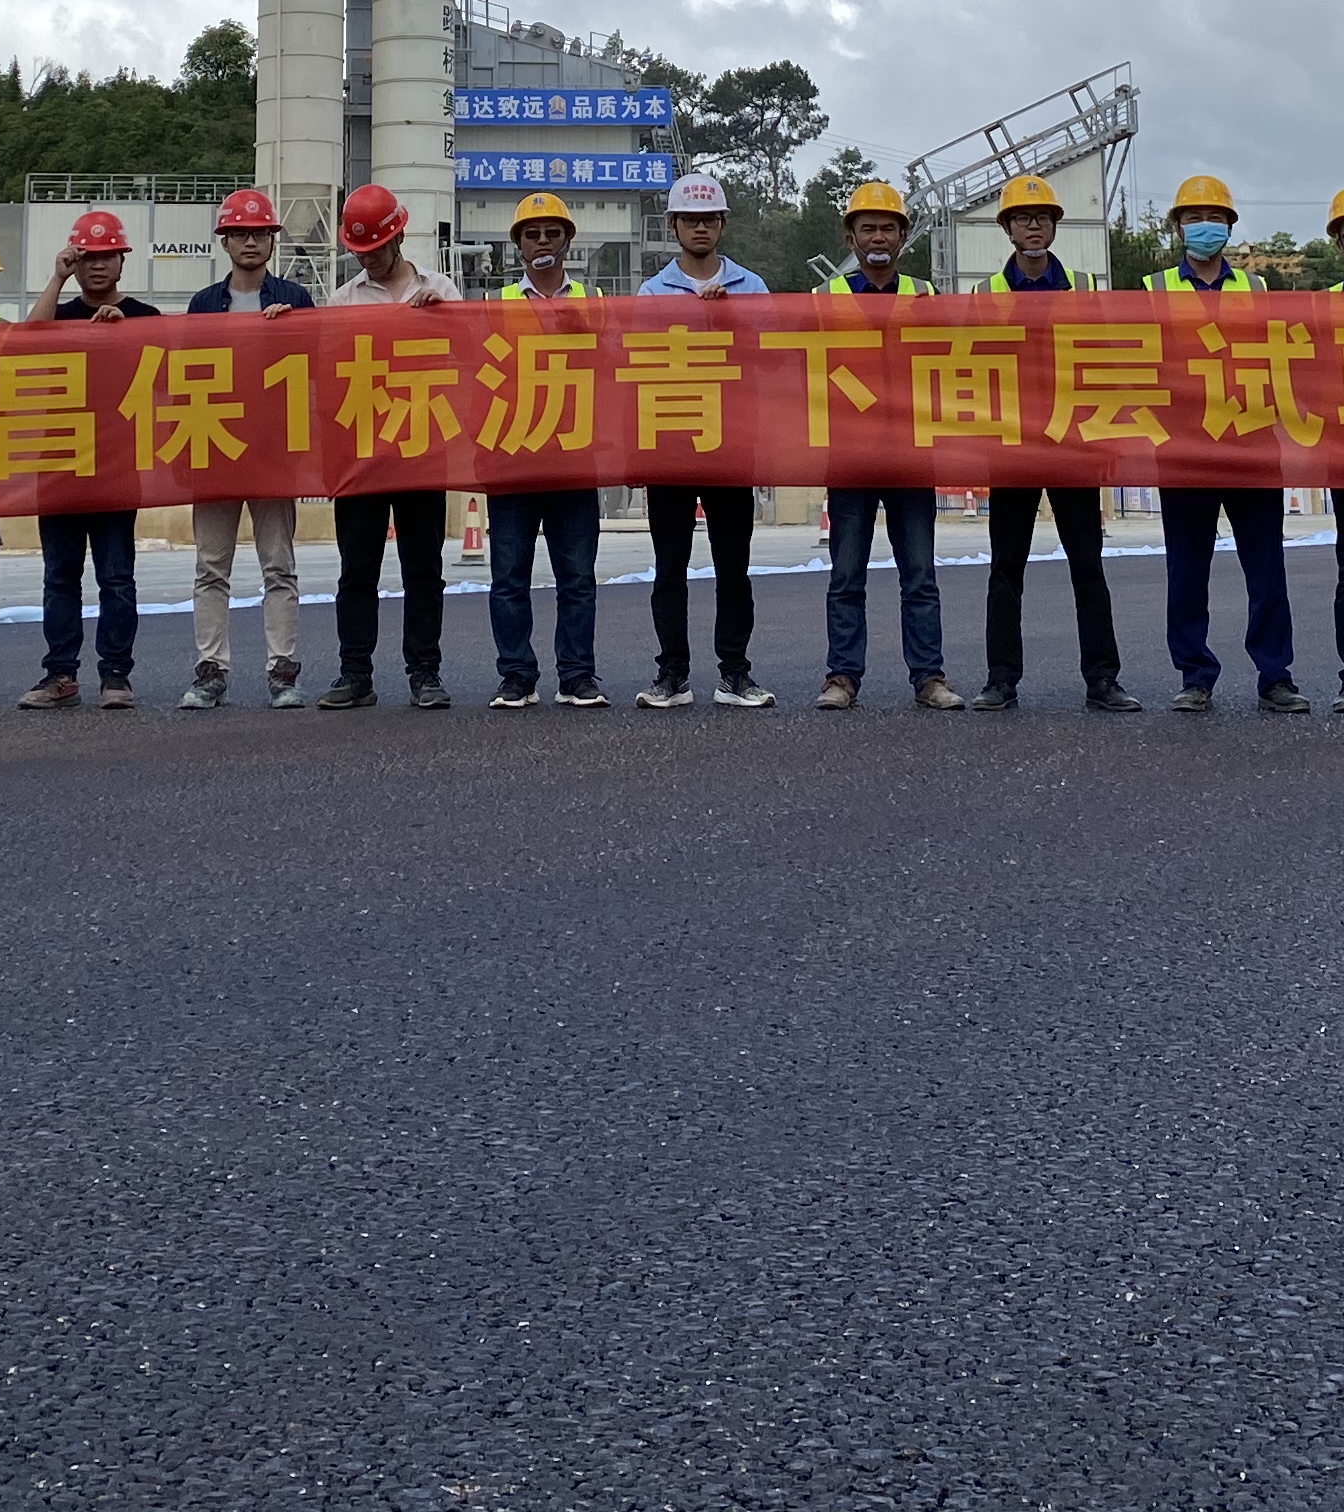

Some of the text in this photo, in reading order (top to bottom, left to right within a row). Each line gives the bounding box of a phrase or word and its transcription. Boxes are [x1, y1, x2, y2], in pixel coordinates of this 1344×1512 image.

[454, 95, 666, 120] 通达致远 品质为本
[572, 158, 667, 183] 精工匠造
[152, 243, 212, 254] MARINI
